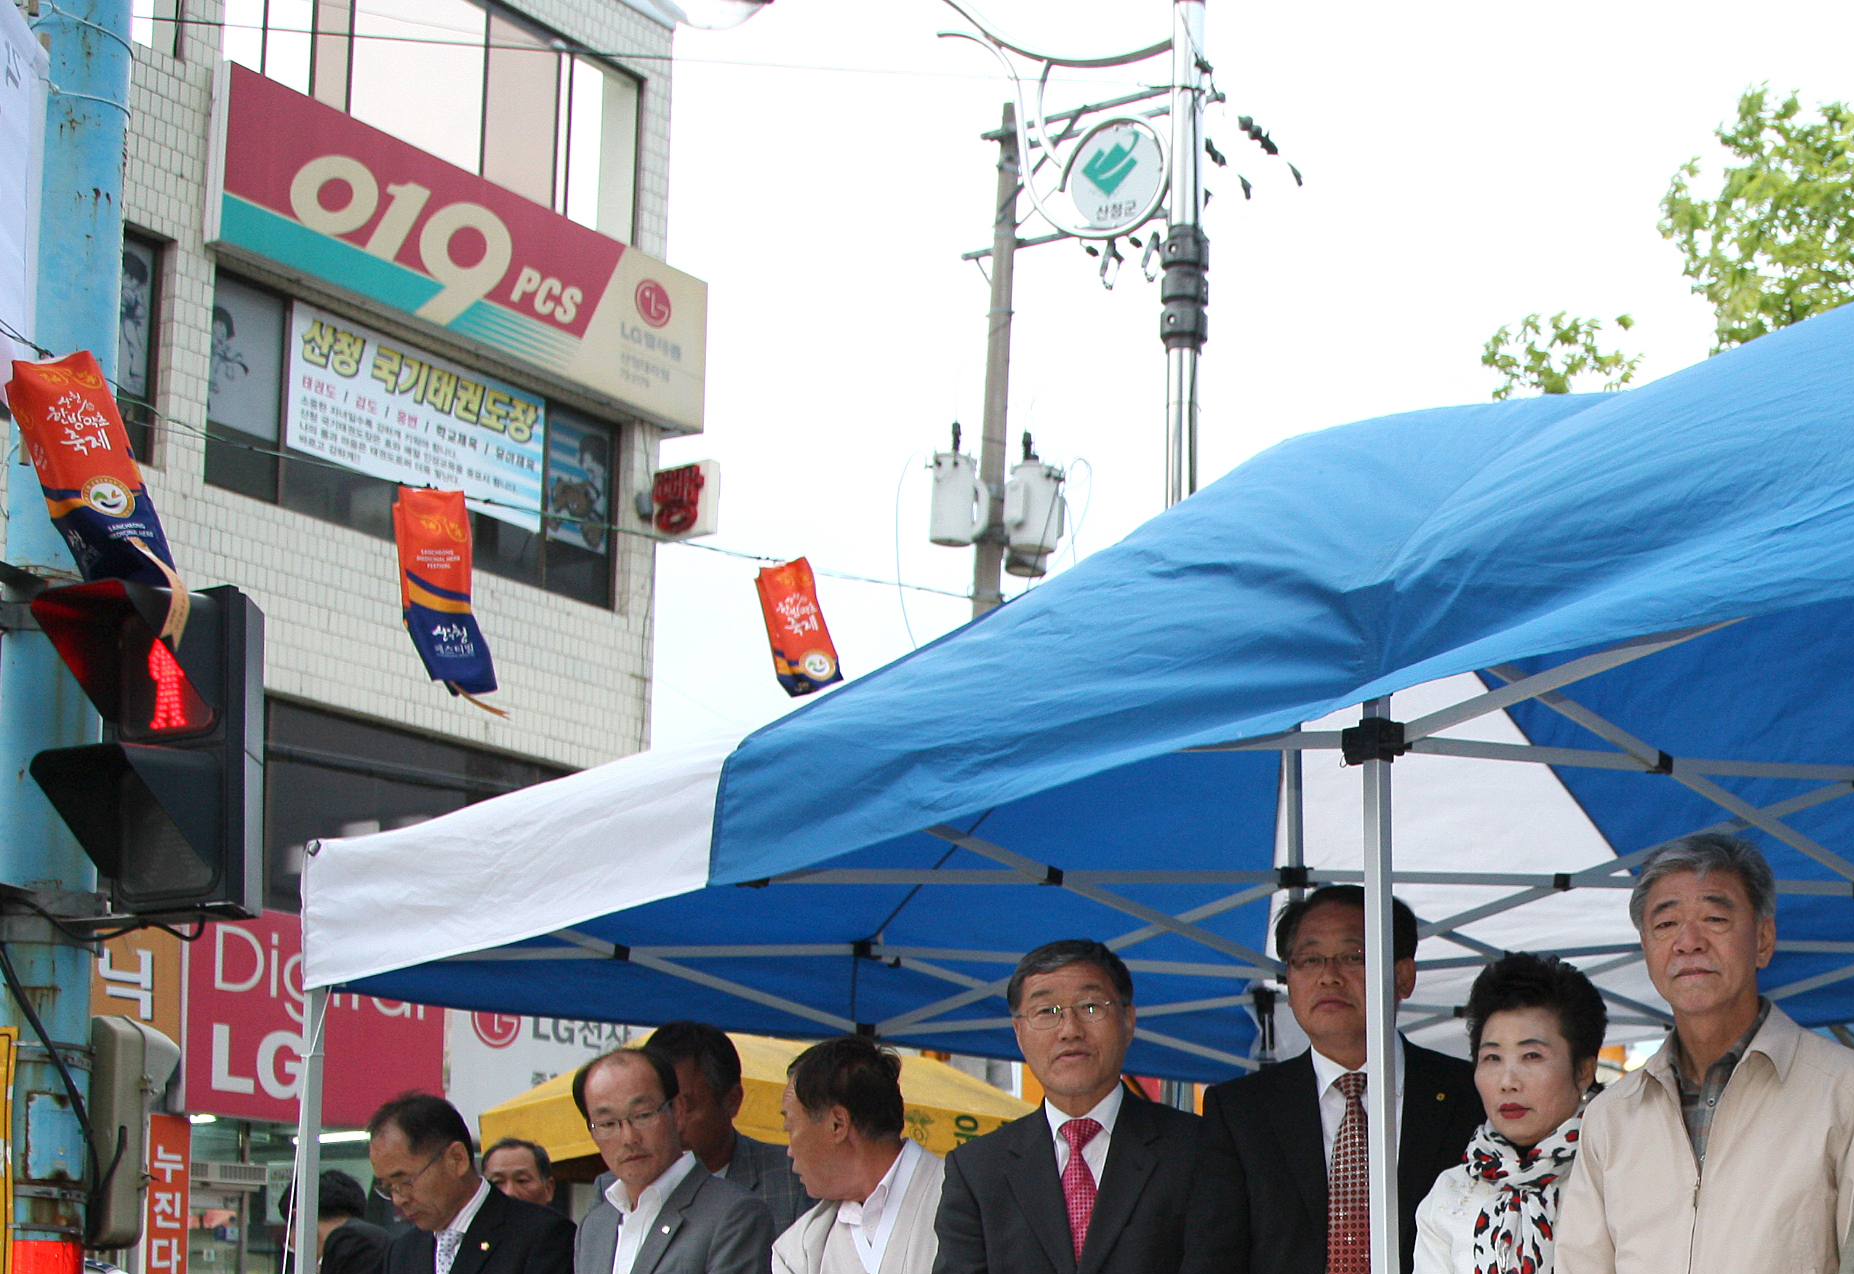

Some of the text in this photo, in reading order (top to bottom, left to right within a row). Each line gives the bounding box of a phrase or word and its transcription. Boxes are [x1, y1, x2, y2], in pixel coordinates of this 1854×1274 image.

[290, 154, 583, 327] 019 PCS
[60, 428, 112, 456] 축제
[301, 320, 539, 444] 산청 국기태권도장
